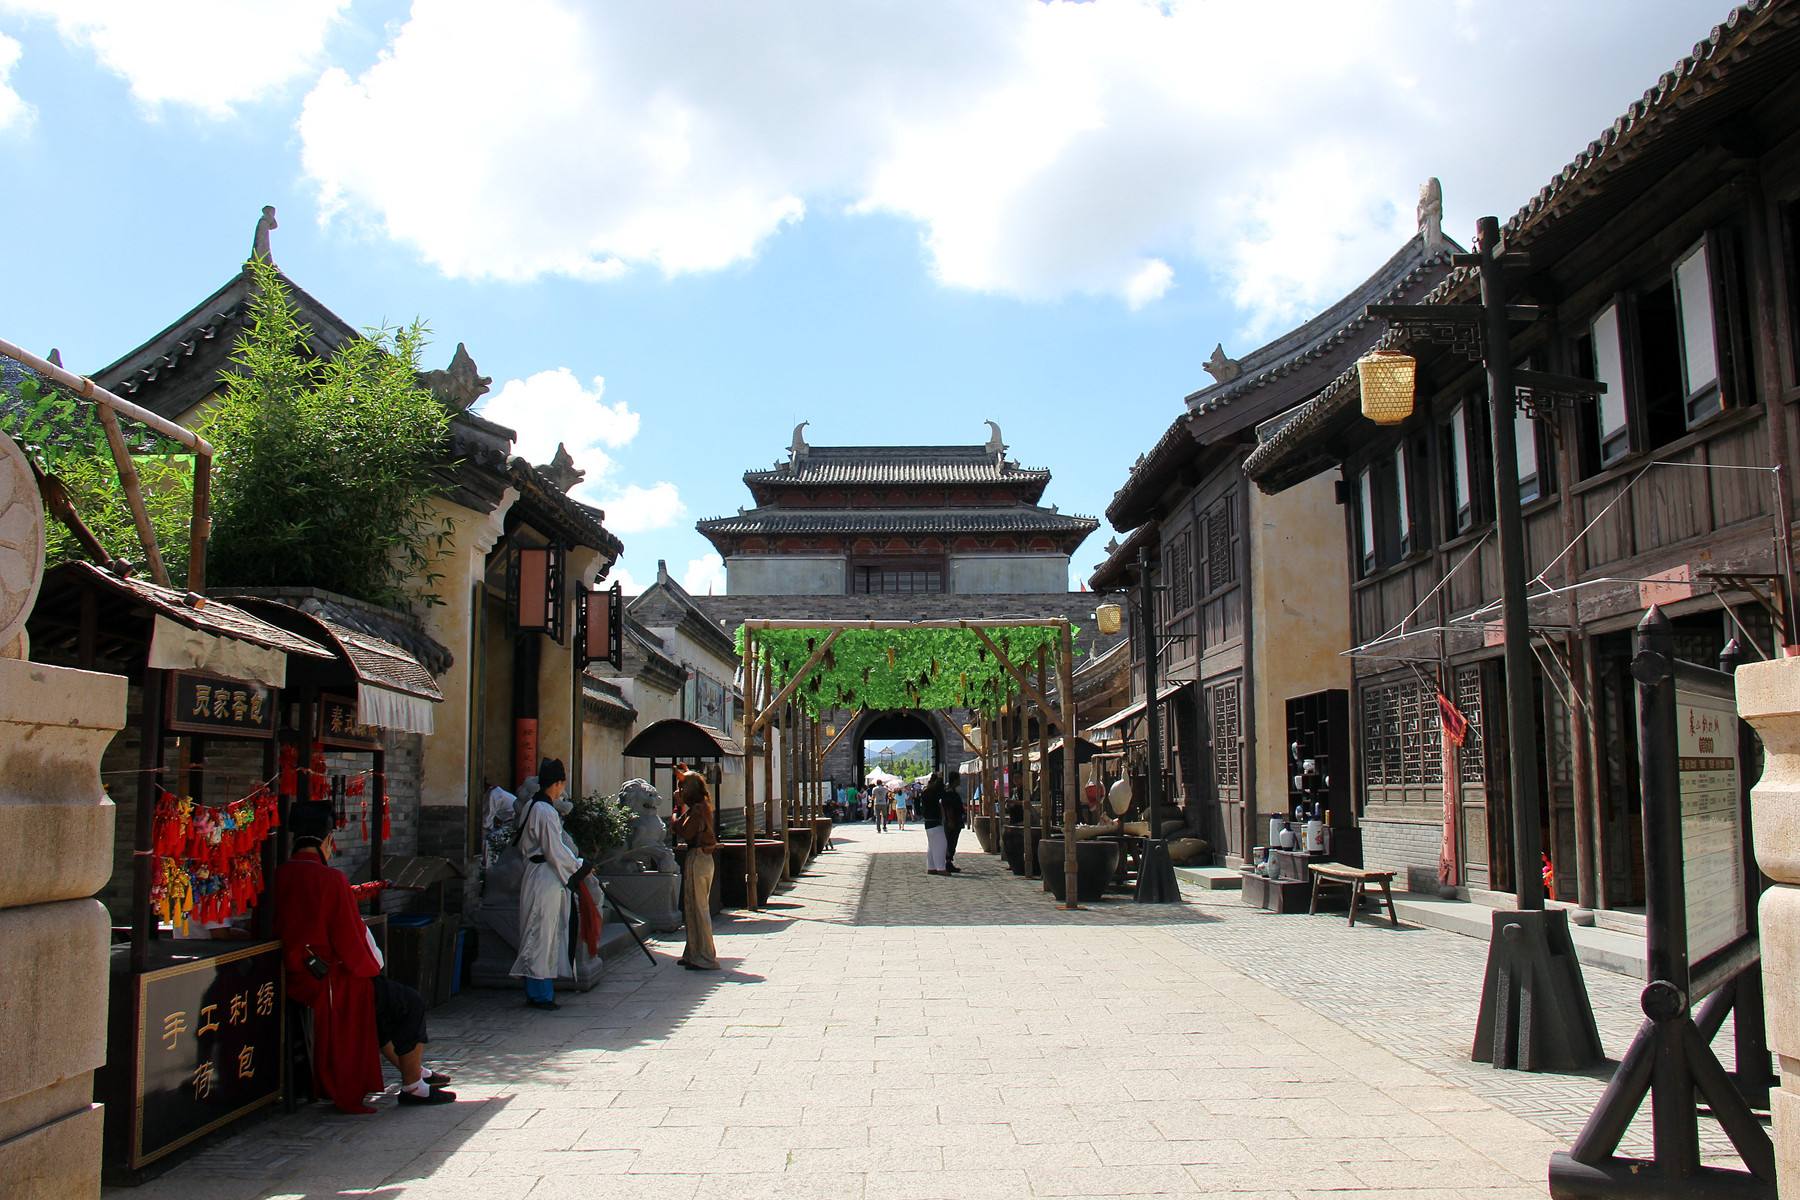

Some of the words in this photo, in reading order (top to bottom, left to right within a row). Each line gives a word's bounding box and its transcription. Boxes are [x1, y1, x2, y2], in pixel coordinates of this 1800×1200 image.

[162, 981, 275, 1050] 手工刺绣
[192, 1044, 256, 1101] 荷包
